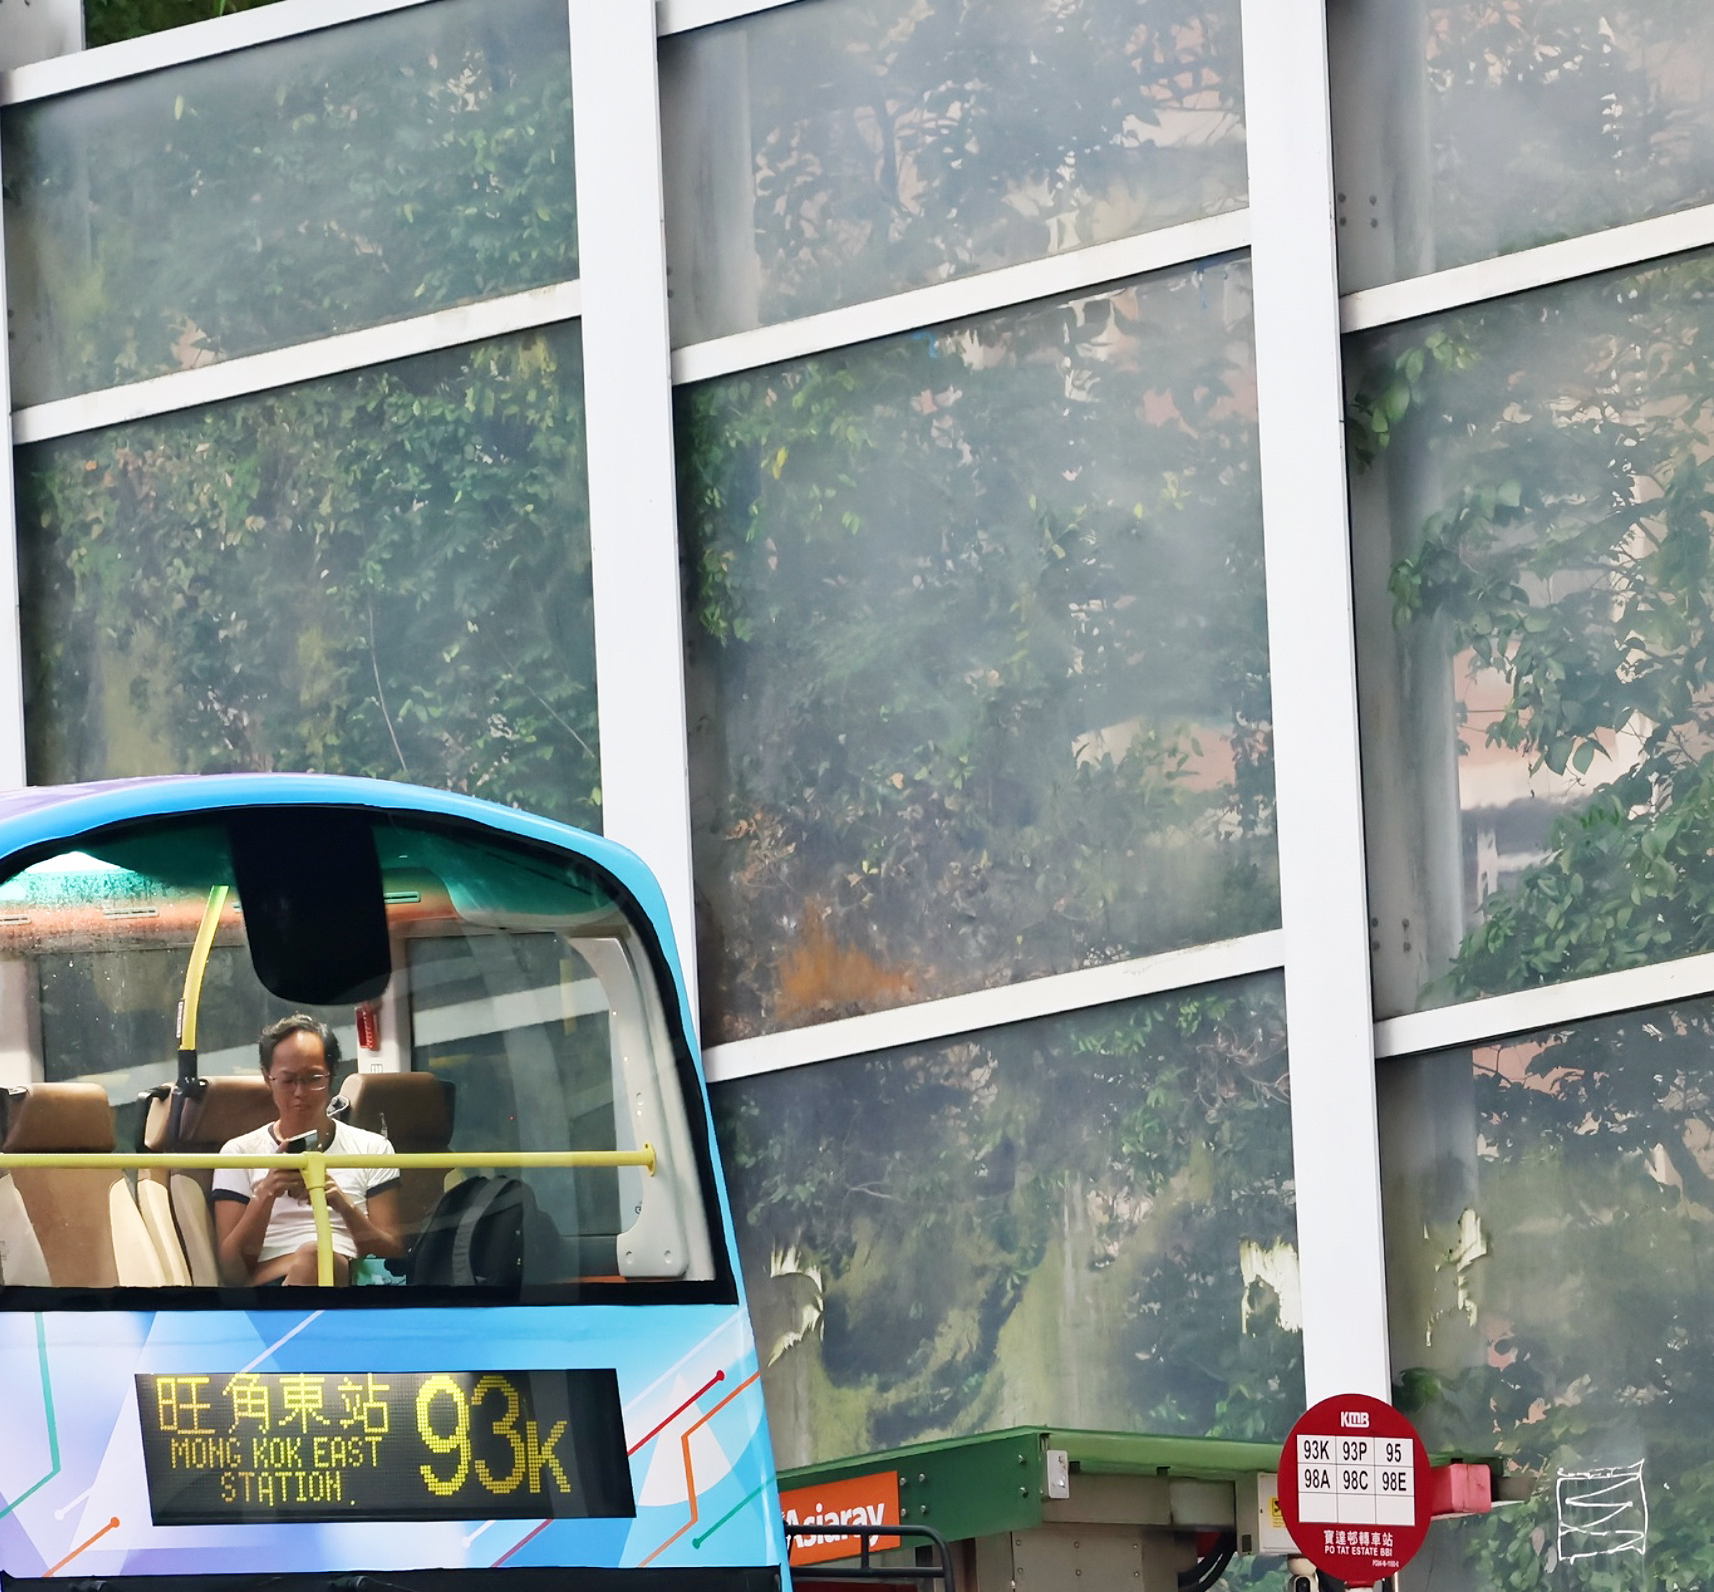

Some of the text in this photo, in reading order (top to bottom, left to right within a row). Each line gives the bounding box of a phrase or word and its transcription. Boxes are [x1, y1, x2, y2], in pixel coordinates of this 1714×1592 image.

[155, 1372, 390, 1436] 旺角東站
[1340, 1411, 1370, 1428] KMB
[415, 1374, 572, 1497] 93K
[171, 1435, 383, 1469] MONG KOK EAST
[1303, 1439, 1402, 1463] 93K 93P 95
[220, 1470, 342, 1506] STATION
[1304, 1468, 1407, 1492] 98A 98C 98E
[1323, 1529, 1394, 1548] 寶達邨轉車站
[1324, 1545, 1393, 1558] PO TAT ESTATE BBI
